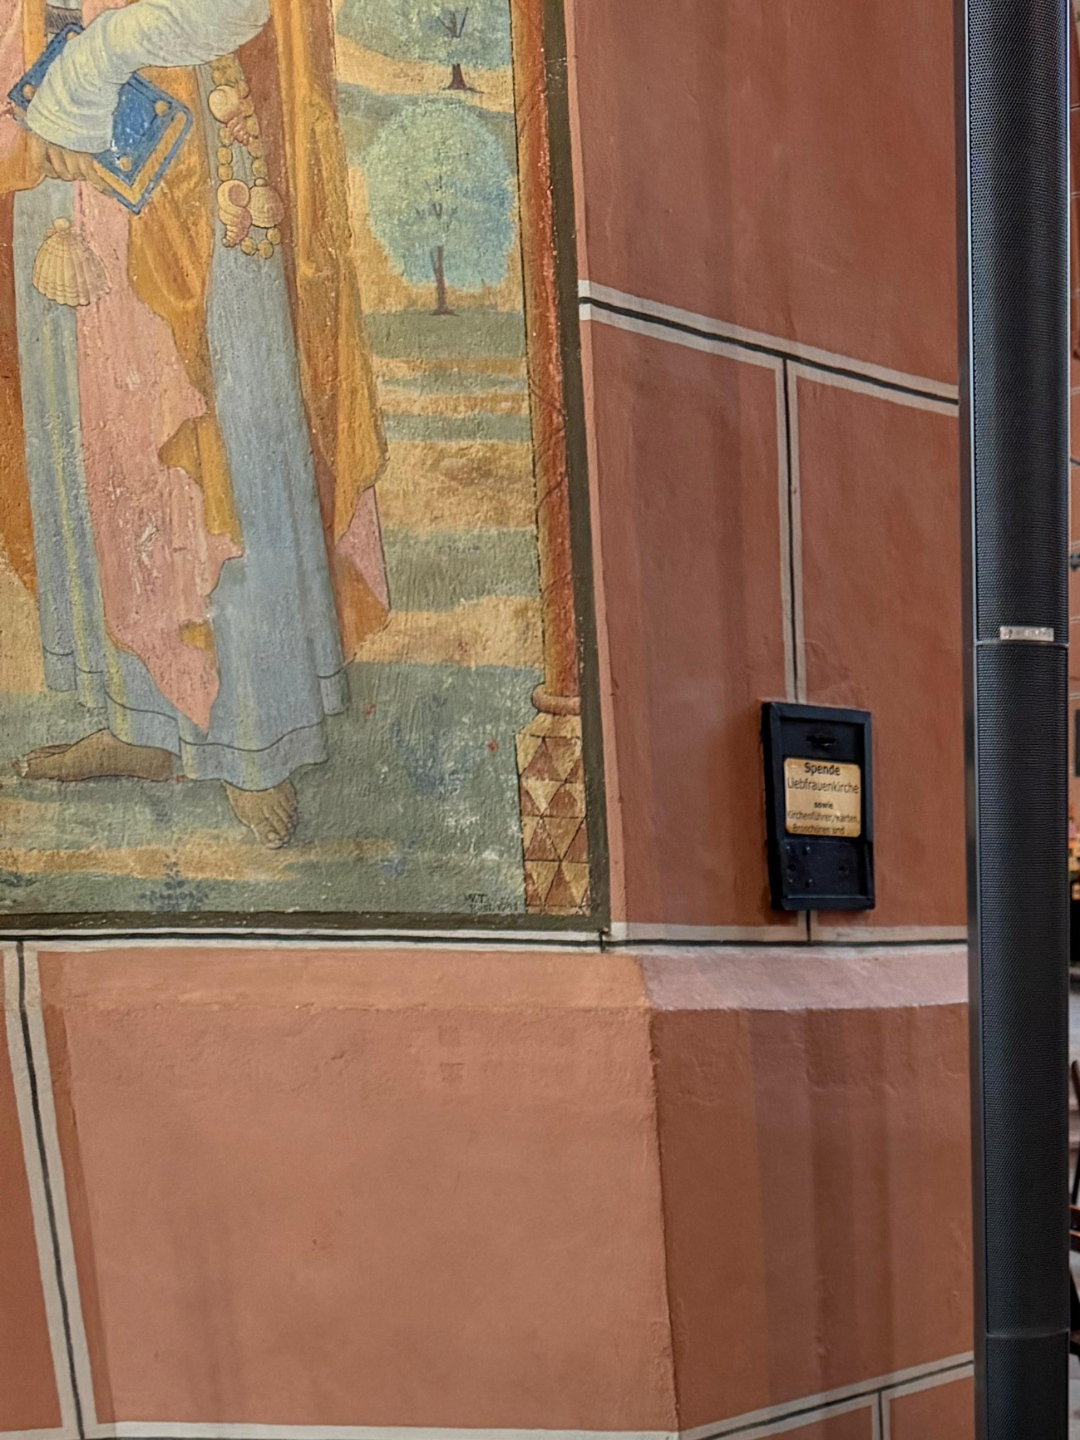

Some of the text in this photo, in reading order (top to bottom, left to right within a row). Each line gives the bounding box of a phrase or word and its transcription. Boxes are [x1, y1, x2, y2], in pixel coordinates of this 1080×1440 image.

[804, 762, 840, 776] Spende
[788, 778, 859, 794] Liebfrauenkirche
[814, 801, 833, 809] sowie
